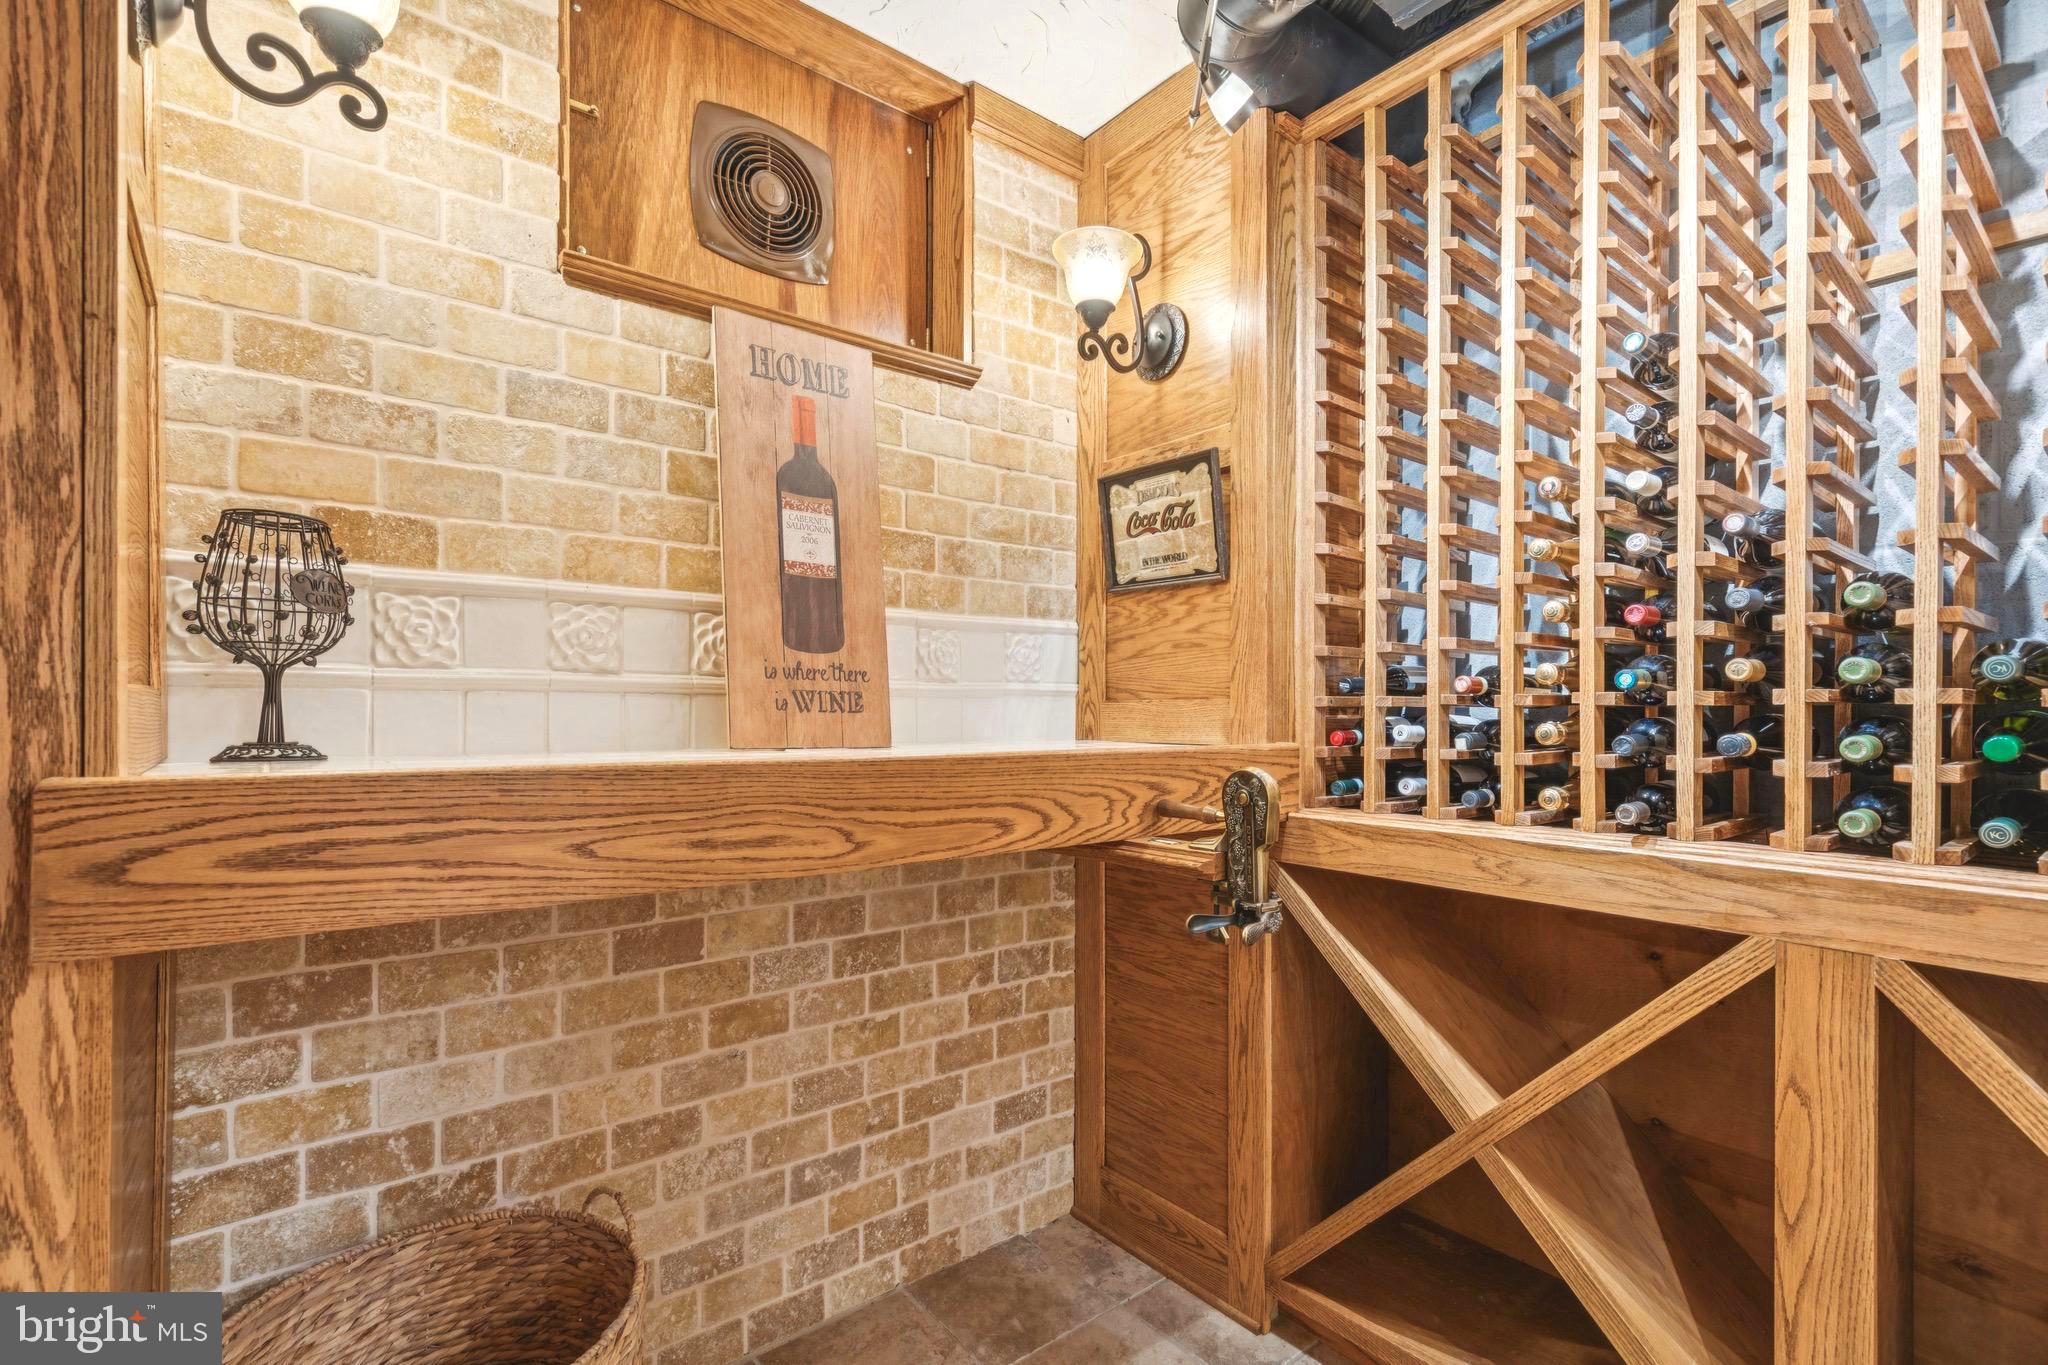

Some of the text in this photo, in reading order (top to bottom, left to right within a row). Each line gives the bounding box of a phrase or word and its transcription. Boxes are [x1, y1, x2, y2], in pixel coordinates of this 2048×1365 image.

[749, 344, 849, 399] HOME
[786, 521, 832, 535] SAUVIGNON
[788, 512, 829, 526] CABERNET
[763, 659, 870, 682] is where there
[775, 689, 864, 714] is WINE
